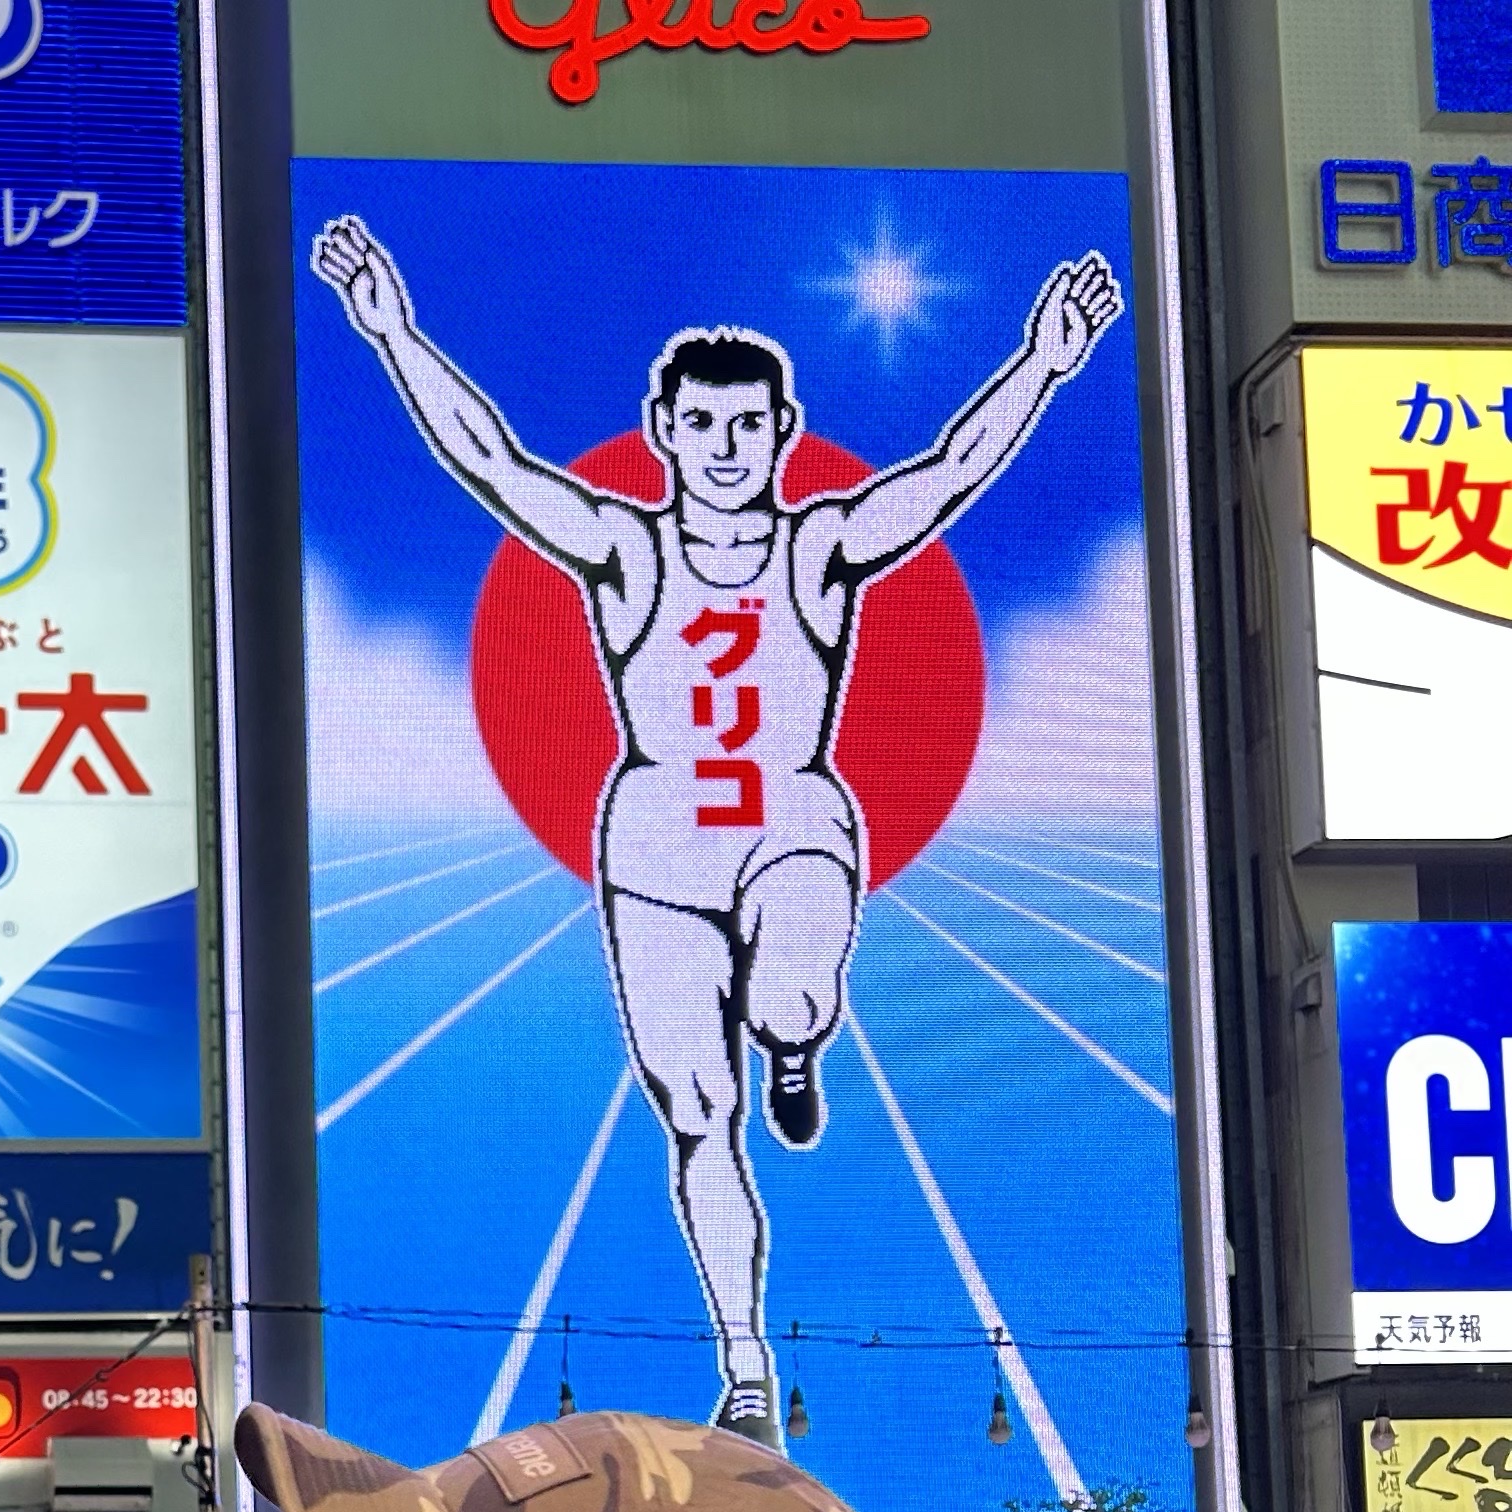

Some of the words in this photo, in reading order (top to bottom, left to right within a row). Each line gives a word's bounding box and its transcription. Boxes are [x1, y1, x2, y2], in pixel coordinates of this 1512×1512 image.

[679, 598, 766, 827] グリコ
[1386, 1034, 1512, 1245] C
[1378, 1315, 1481, 1343] 天気予報
